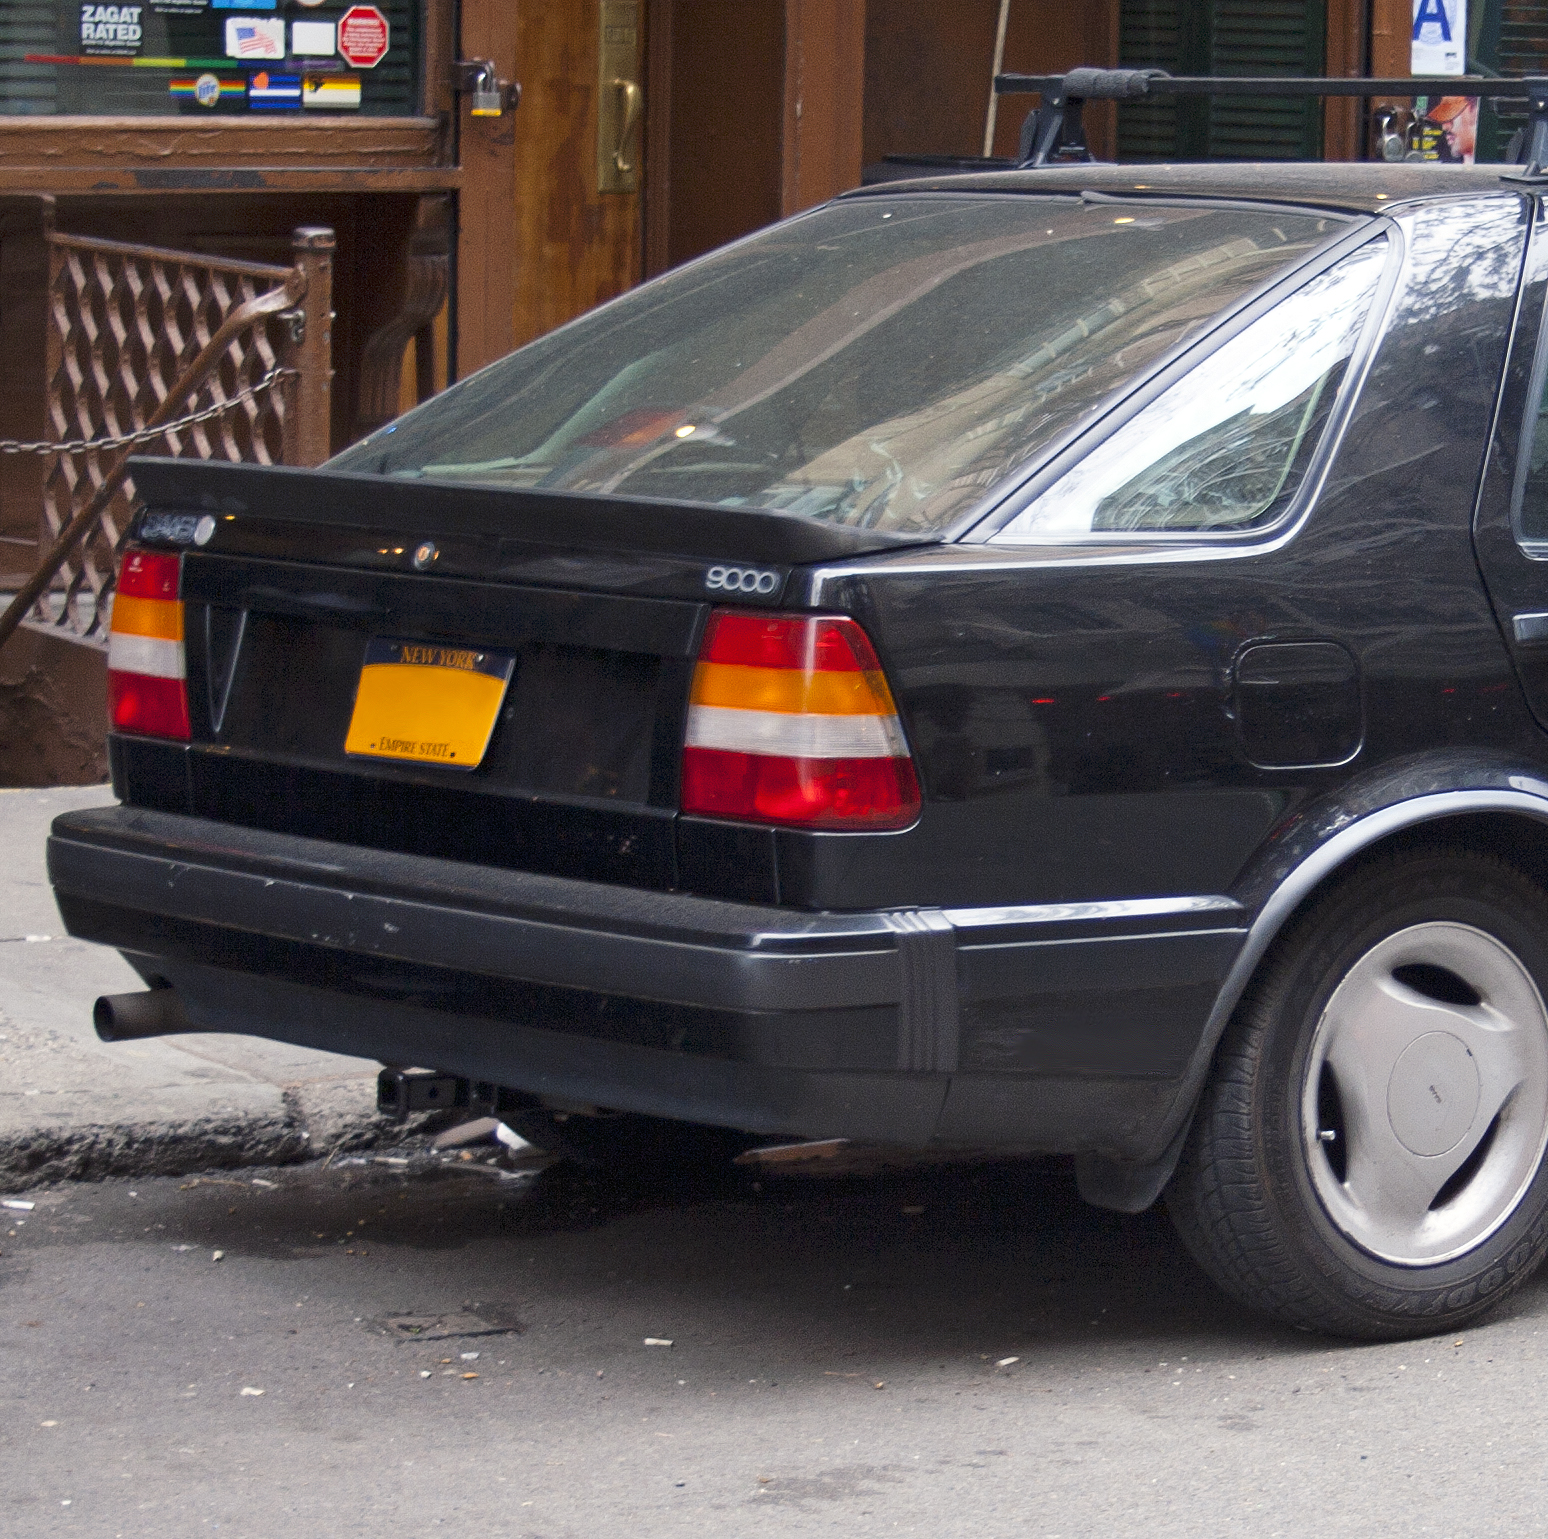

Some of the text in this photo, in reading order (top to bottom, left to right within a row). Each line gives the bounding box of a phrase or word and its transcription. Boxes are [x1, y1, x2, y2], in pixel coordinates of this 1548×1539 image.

[82, 5, 142, 23] ZAGAT
[1412, 0, 1452, 41] A
[82, 23, 142, 40] RATED
[706, 566, 775, 594] 9000
[401, 646, 478, 670] NEW YORK
[379, 737, 449, 758] EMPIRE STATE
